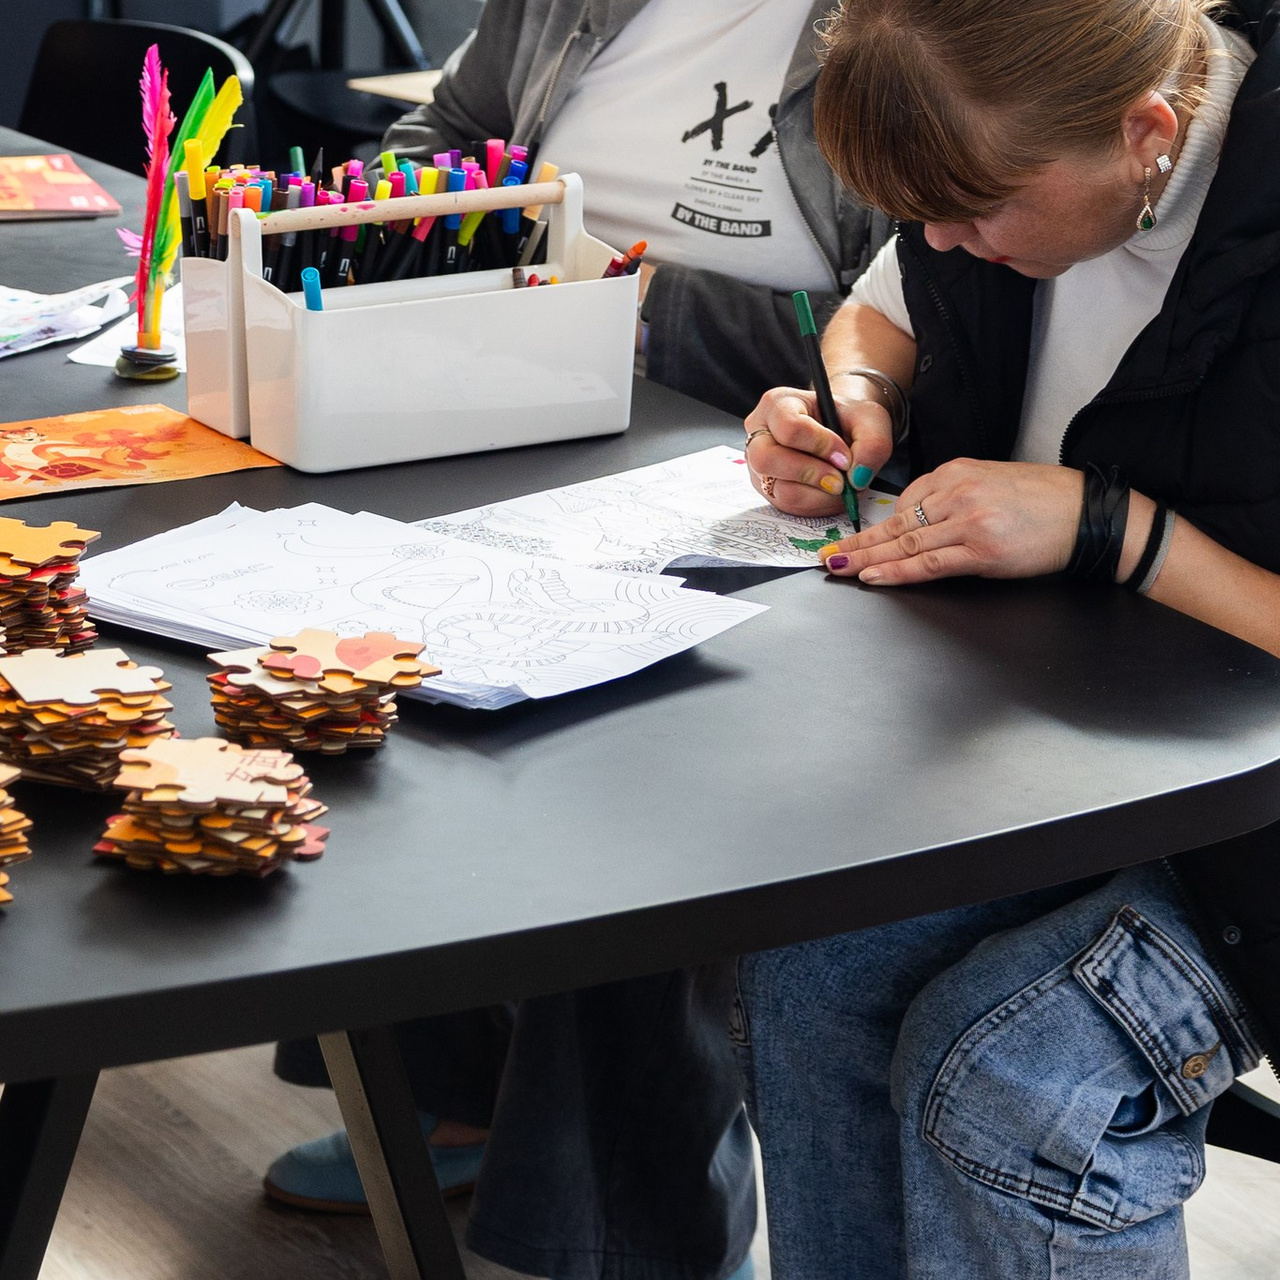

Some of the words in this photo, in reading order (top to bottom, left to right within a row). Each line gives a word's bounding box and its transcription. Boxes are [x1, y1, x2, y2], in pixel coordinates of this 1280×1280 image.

[703, 159, 714, 167] BY
[715, 161, 730, 170] THE
[732, 163, 757, 174] BAND
[675, 205, 693, 223] BY
[694, 213, 719, 231] THE
[720, 220, 763, 236] BAND
